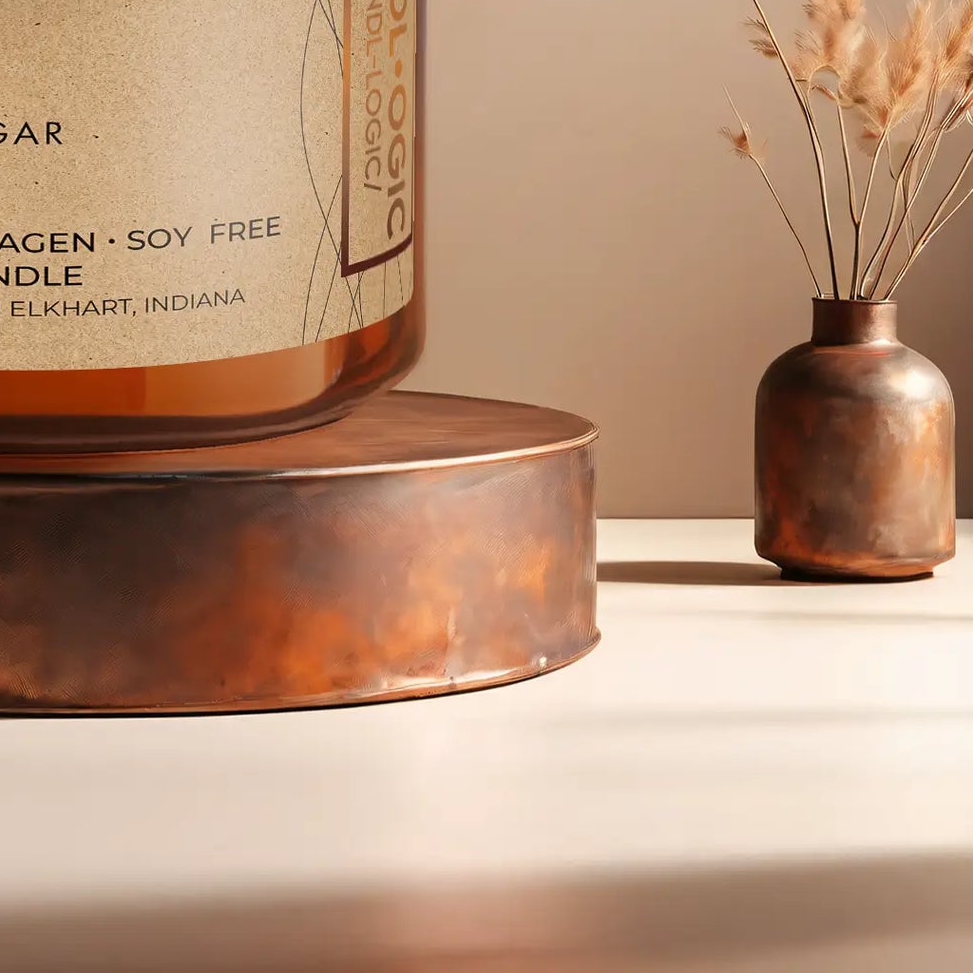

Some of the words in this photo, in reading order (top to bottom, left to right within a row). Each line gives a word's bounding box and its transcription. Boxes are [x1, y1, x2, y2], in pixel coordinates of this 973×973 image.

[126, 226, 193, 251] SOY
[210, 215, 281, 244] FREE
[10, 297, 137, 318] ELKHART,
[144, 288, 246, 314] INDIANA
